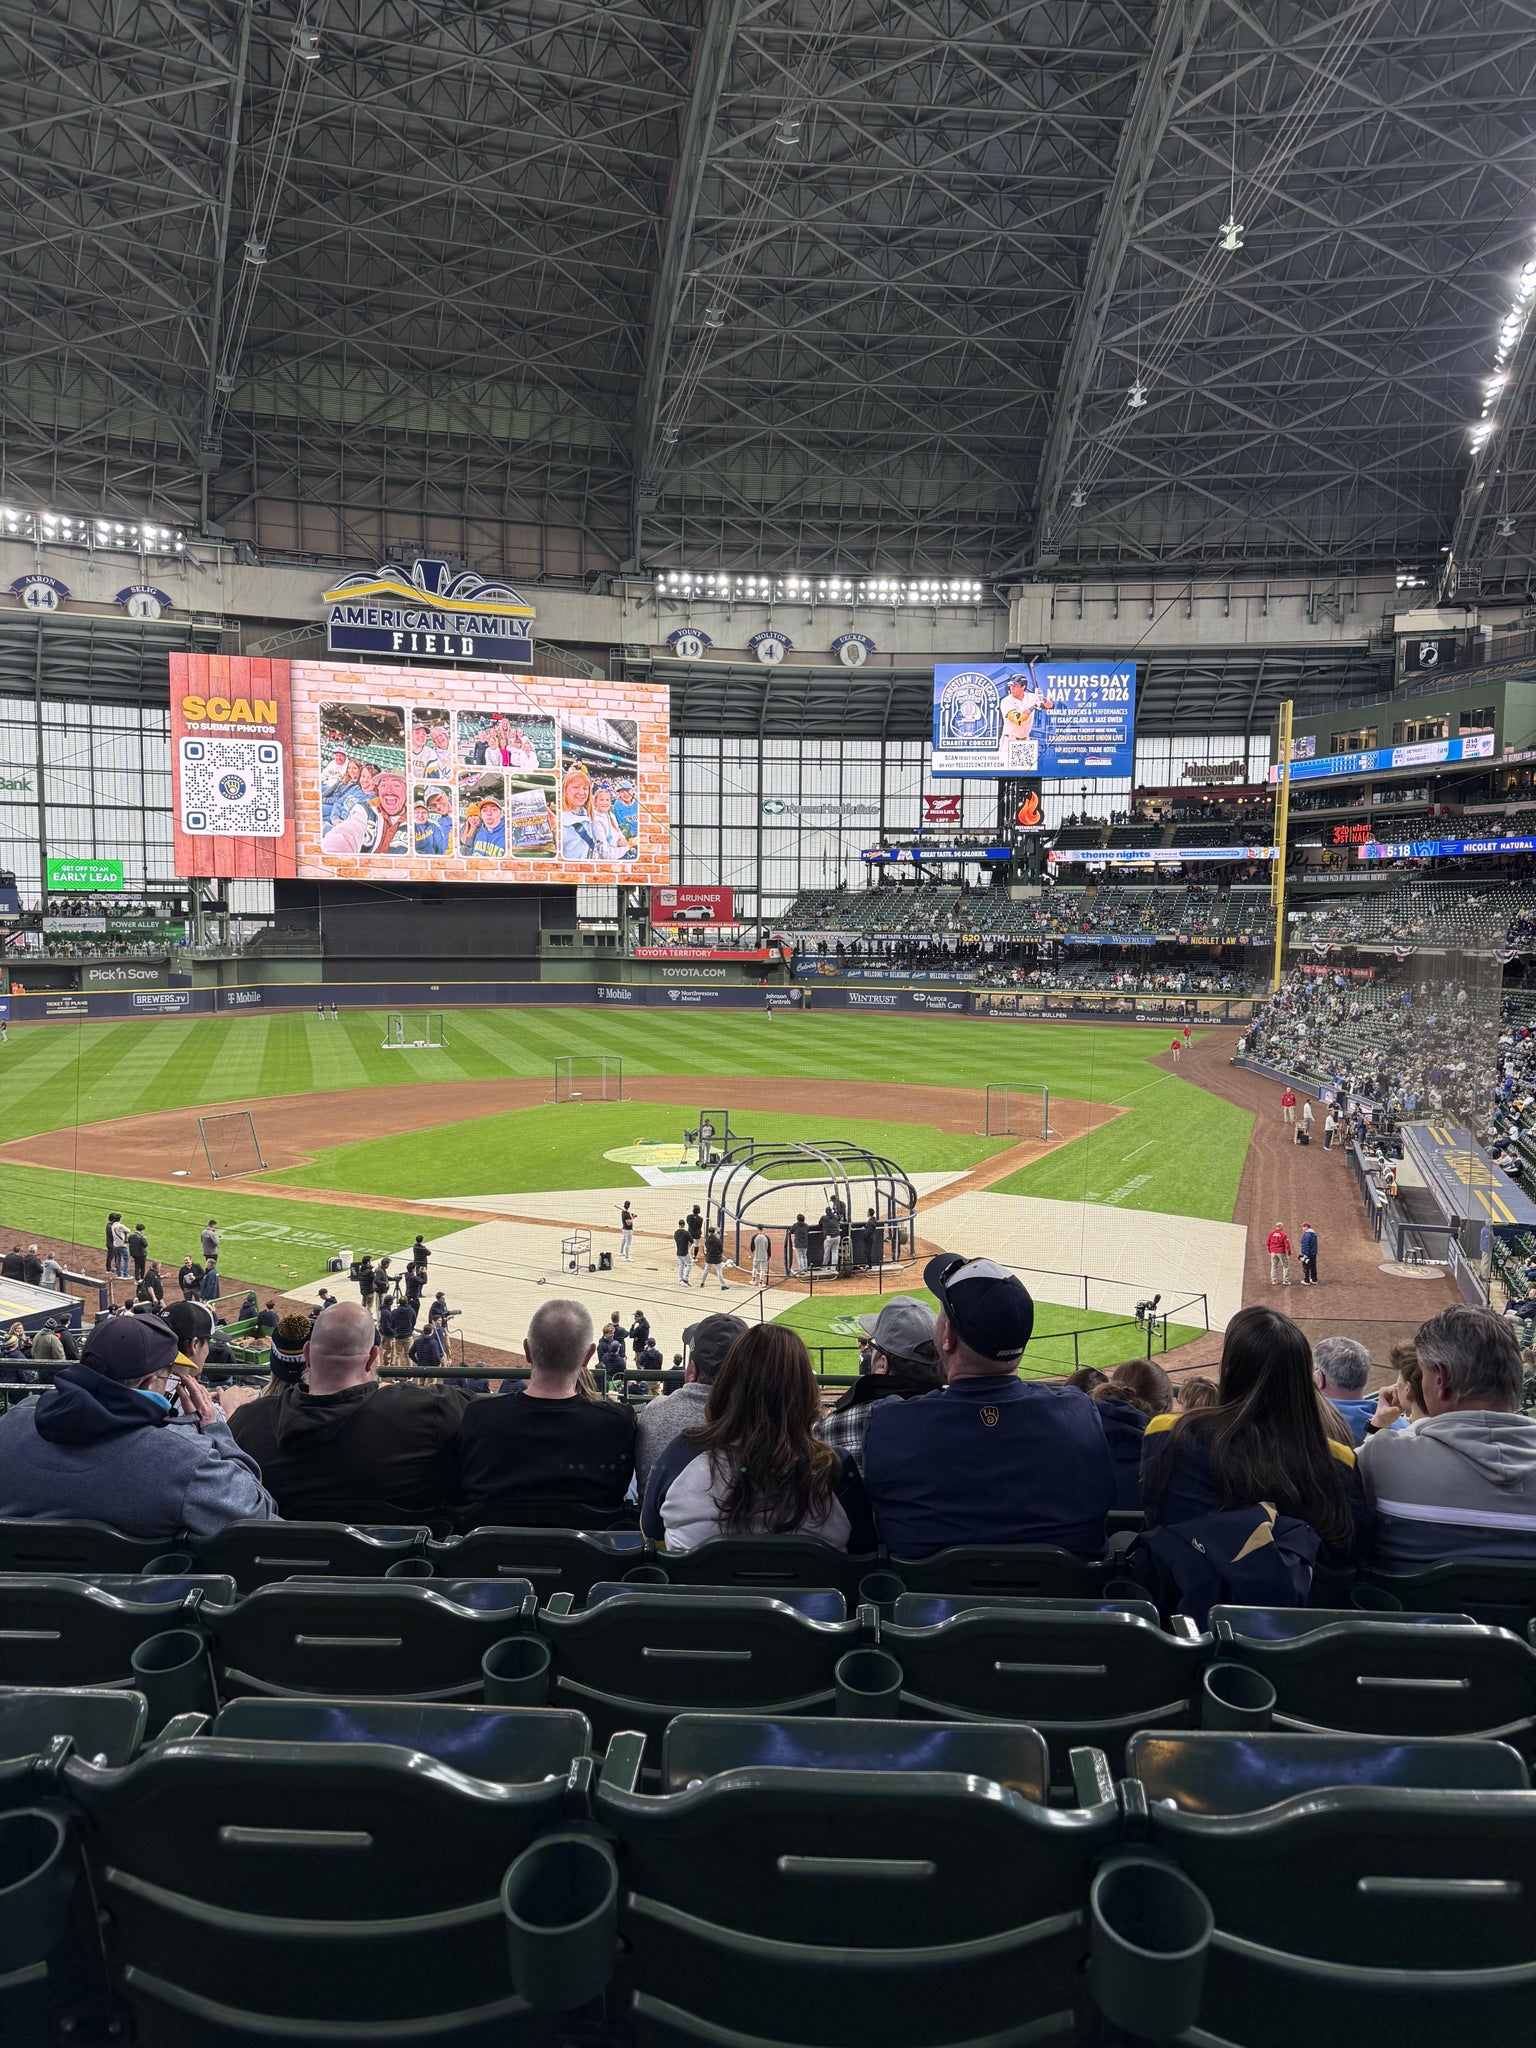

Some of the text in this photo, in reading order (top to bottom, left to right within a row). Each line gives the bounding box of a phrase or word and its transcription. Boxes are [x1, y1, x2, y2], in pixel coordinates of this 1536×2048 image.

[25, 576, 56, 586] AARON
[131, 586, 157, 595] SELIG
[27, 590, 55, 608] 44
[141, 601, 149, 616] 1
[329, 606, 531, 638] AMERICAN FAMILY
[677, 629, 702, 638] YOUNT
[755, 632, 787, 643] MOLITOR
[392, 632, 474, 655] FIELD
[680, 641, 699, 656] 19
[764, 644, 774, 659] 4
[1047, 674, 1130, 688] THURSDAY
[944, 675, 997, 702] CHRISTIAN YELICH'S
[1047, 688, 1130, 701] MAY 21 2026
[182, 695, 278, 724] SCAN
[185, 722, 276, 734] TO SUBMIT PHOTOS
[1181, 761, 1247, 778] Johnsonville
[1352, 824, 1371, 832] MARKET
[1386, 845, 1411, 857] 5:18
[1463, 842, 1497, 852] NICOLET
[1500, 841, 1534, 850] NATURAL
[1116, 850, 1151, 859] nights
[53, 873, 117, 882] EARLY LEAD
[679, 894, 721, 903] 4RUNNER
[962, 934, 1010, 942] 620 WTMJ
[1111, 935, 1153, 944] WINTRUST
[1190, 936, 1237, 945] NICOLET LAW
[637, 949, 712, 957] TOYOTA TERRITORY
[88, 967, 159, 980] Pick'n Save
[662, 968, 726, 977] TOYOTA.COM
[136, 994, 186, 1004] BREWERS.TV
[236, 991, 261, 1004] Mobile
[605, 988, 632, 1000] Mobile
[766, 992, 788, 1000] Johnson
[849, 992, 897, 1003] WINTRUST
[926, 1001, 947, 1009] Health
